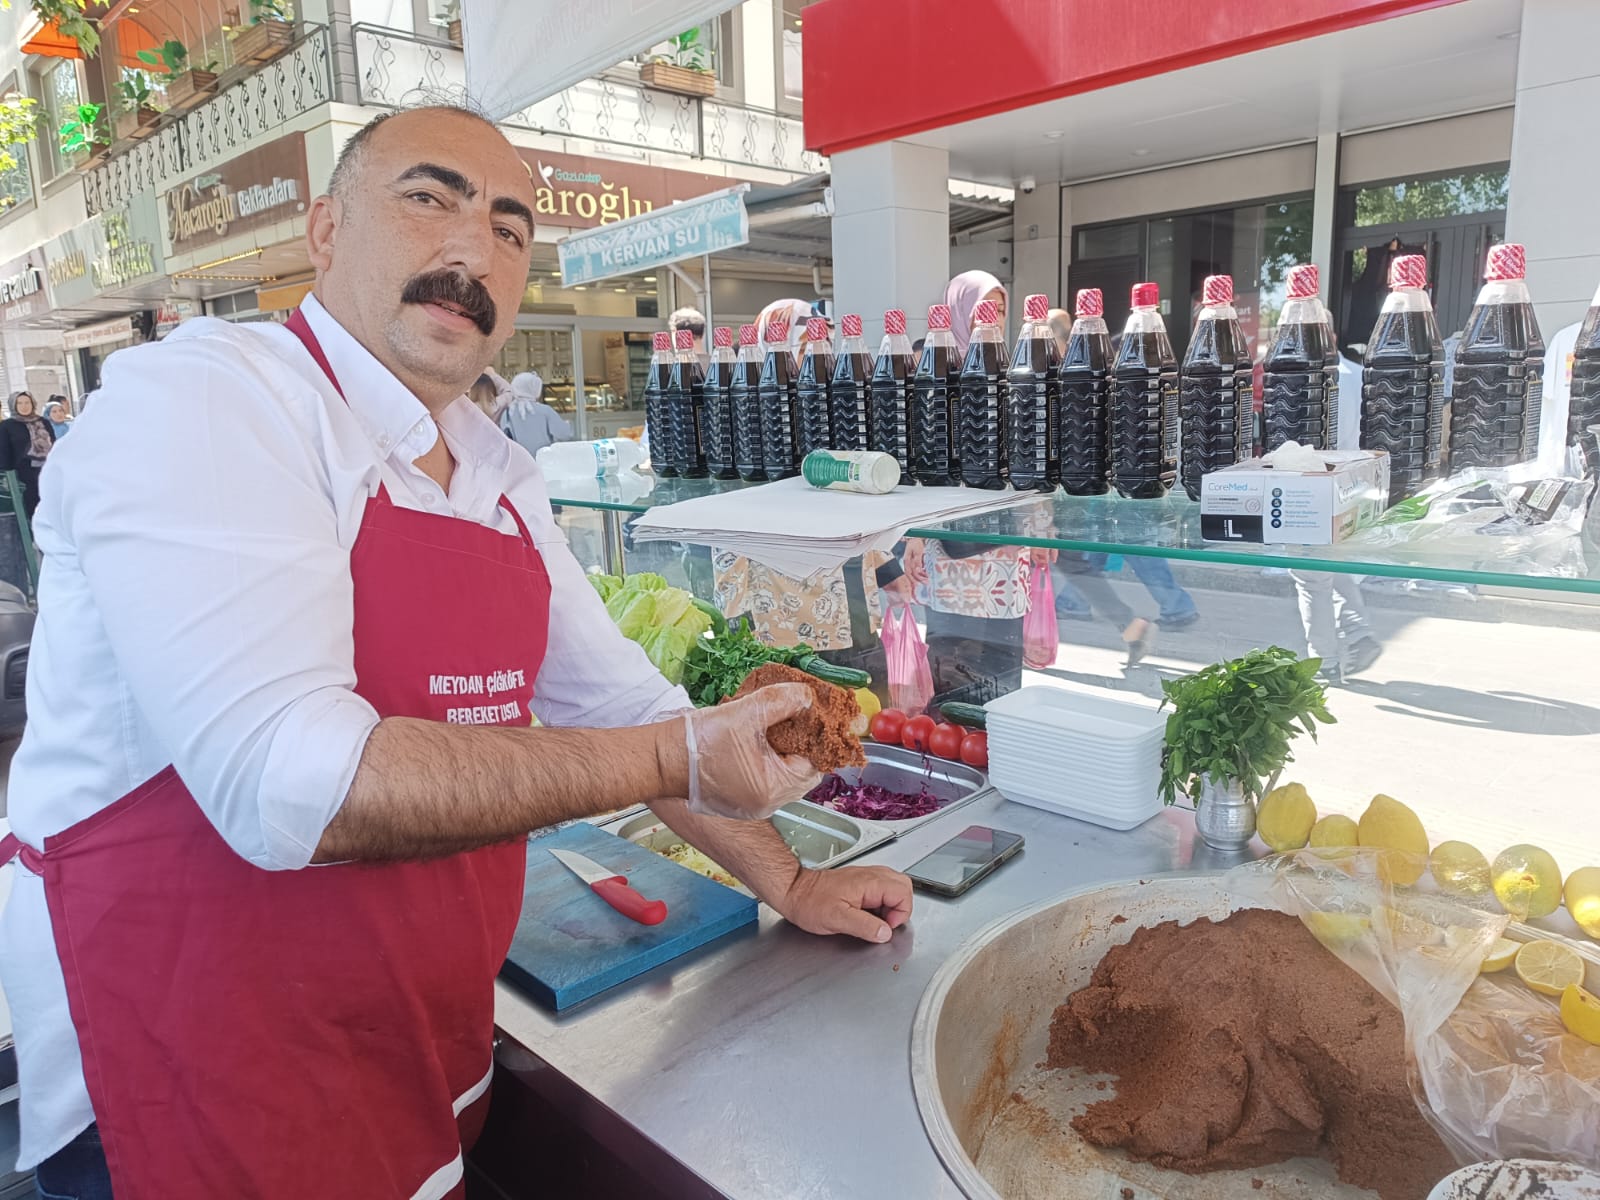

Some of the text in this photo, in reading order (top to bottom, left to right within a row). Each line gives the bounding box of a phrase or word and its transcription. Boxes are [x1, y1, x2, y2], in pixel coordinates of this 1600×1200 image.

[536, 181, 653, 226] aroğlu
[601, 227, 701, 268] KERVAN SU
[592, 426, 607, 438] 80
[1208, 482, 1249, 492] CoreMed
[1228, 519, 1244, 538] L
[429, 674, 484, 696] MEYDAN
[446, 700, 522, 726] BEREKET USTA
